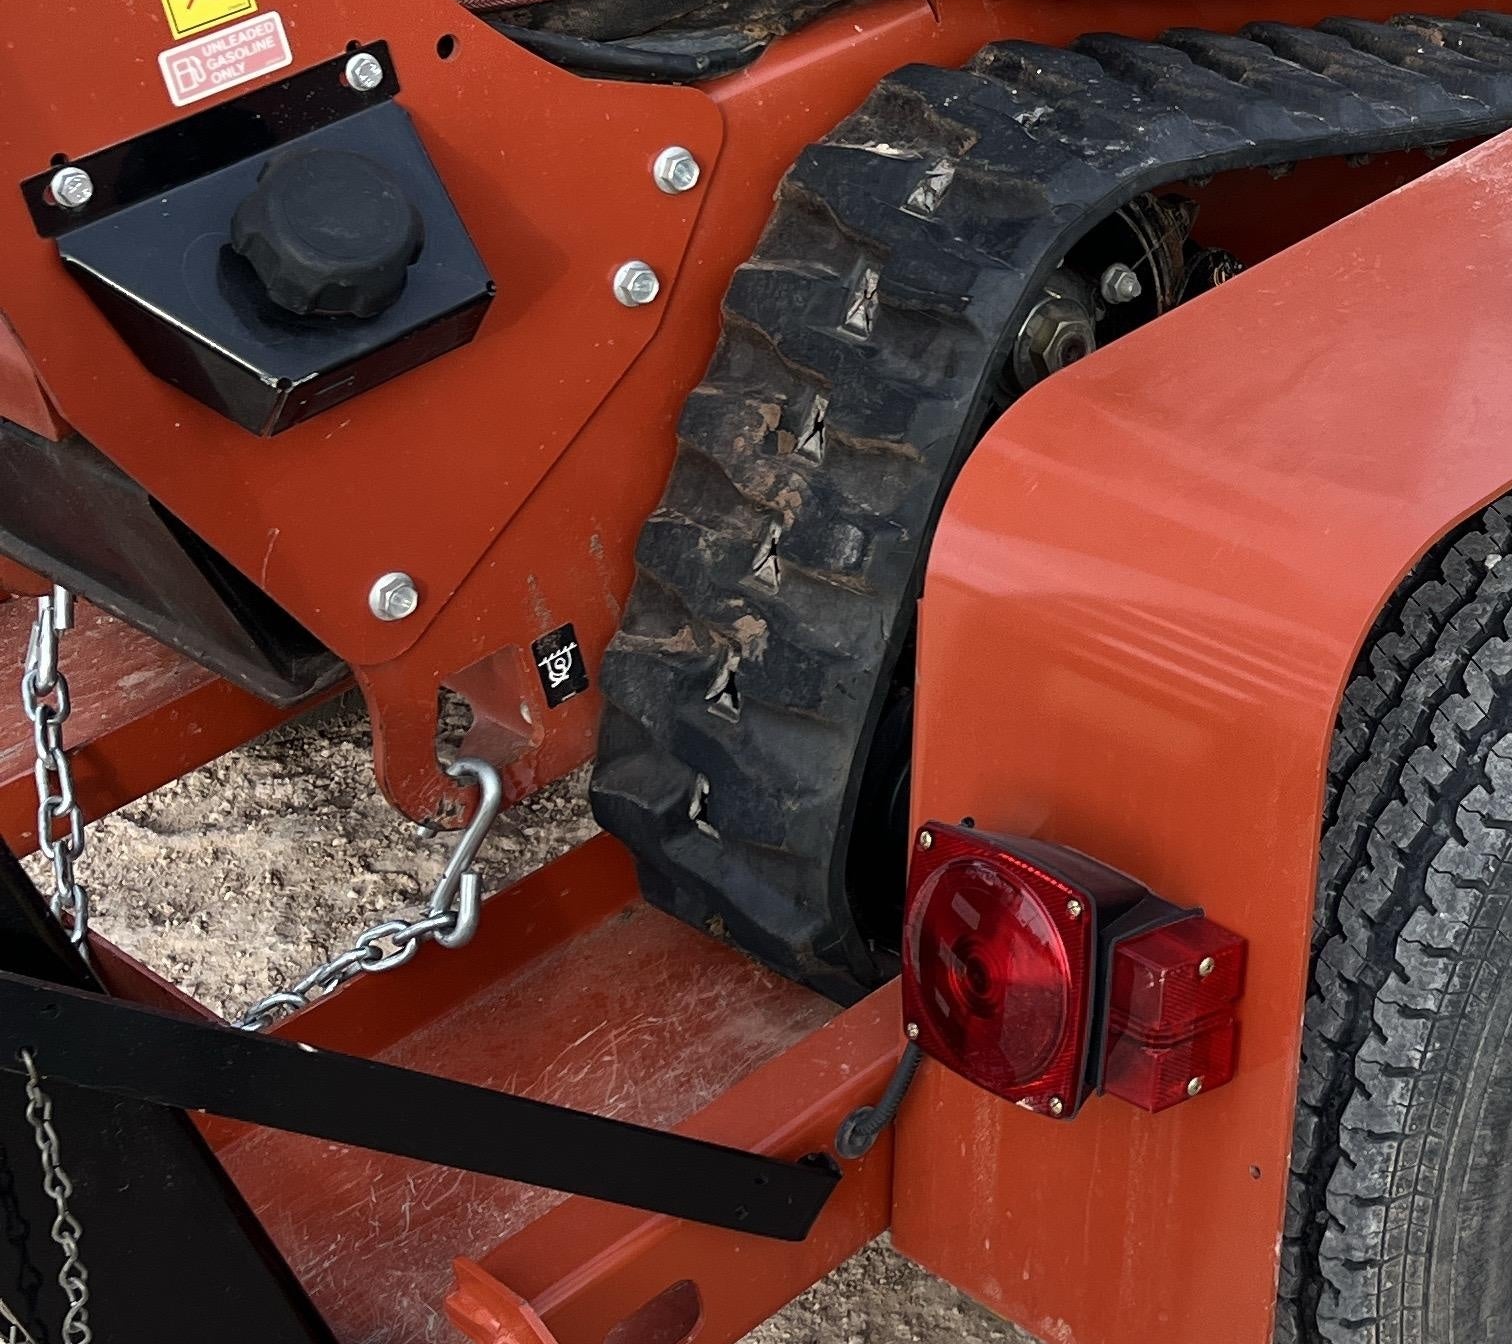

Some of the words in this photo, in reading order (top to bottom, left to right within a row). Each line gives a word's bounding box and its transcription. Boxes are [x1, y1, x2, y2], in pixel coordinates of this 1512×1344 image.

[201, 21, 276, 56] UNLEADED
[206, 35, 276, 70] GASOLINE
[211, 63, 247, 85] ONLY
